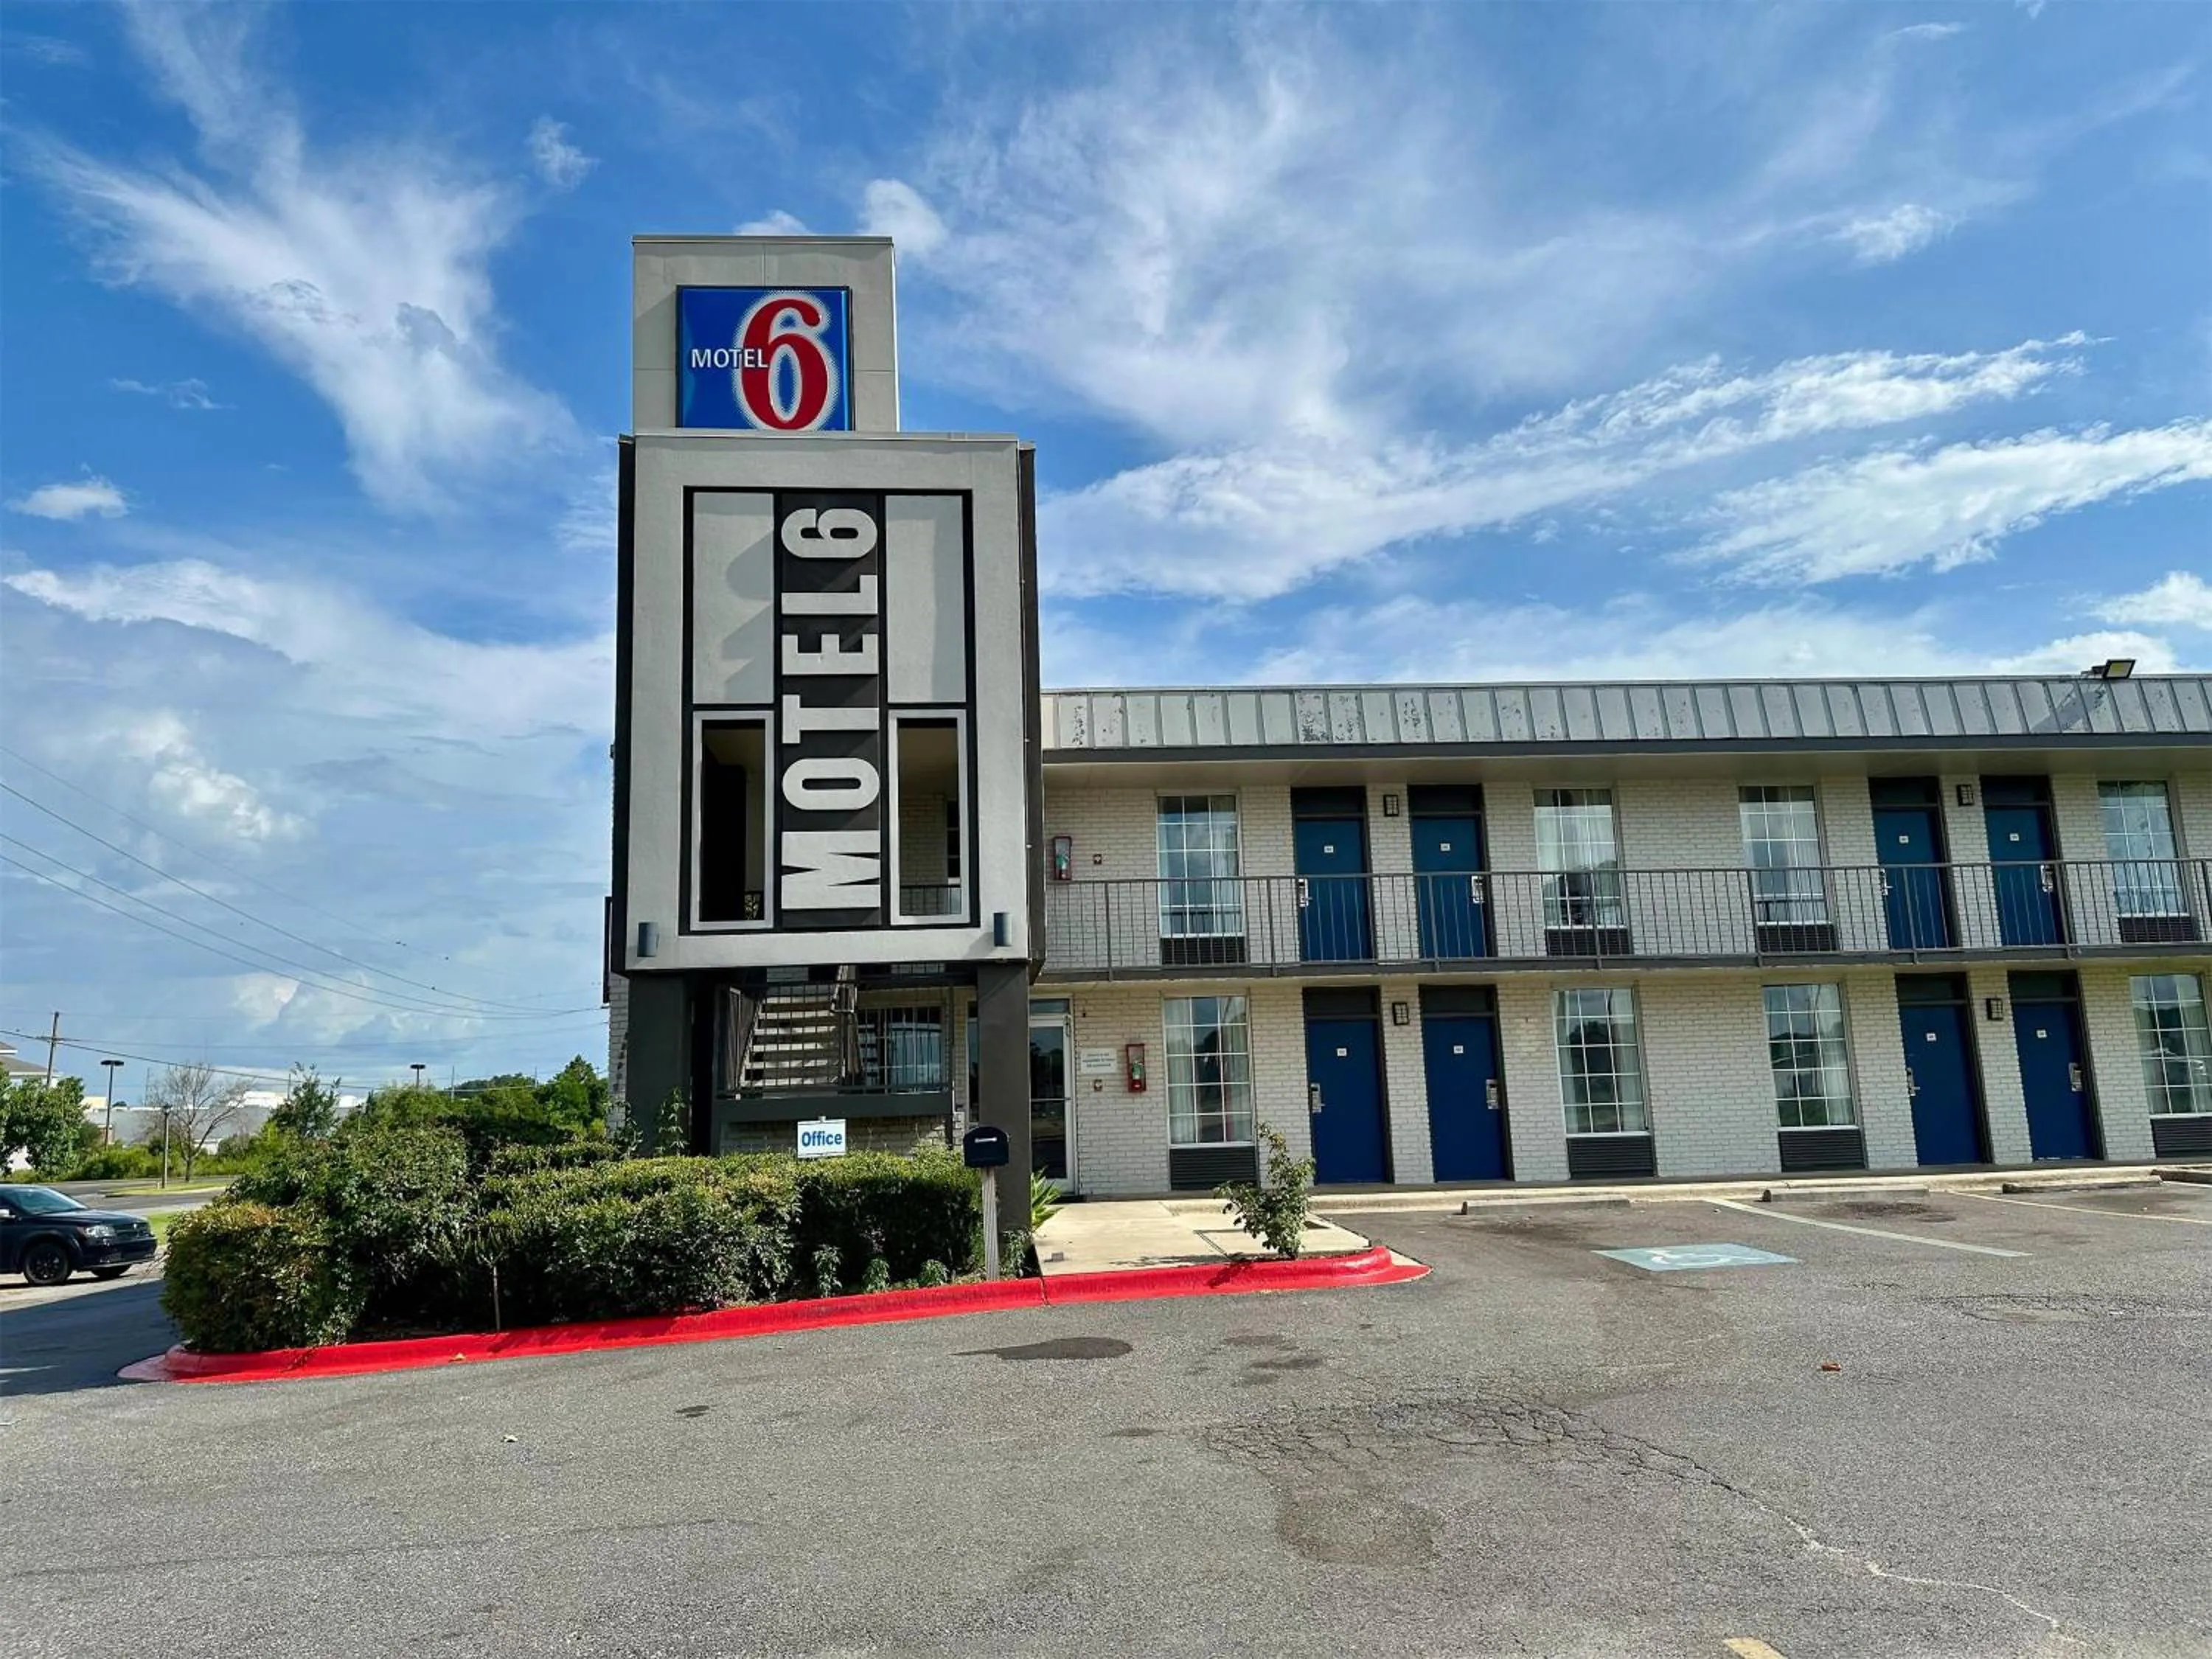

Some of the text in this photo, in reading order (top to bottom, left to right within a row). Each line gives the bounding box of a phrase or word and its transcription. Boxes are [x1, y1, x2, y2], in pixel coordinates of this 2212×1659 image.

[691, 298, 829, 430] MOTEL 6
[801, 1130, 843, 1147] Office
